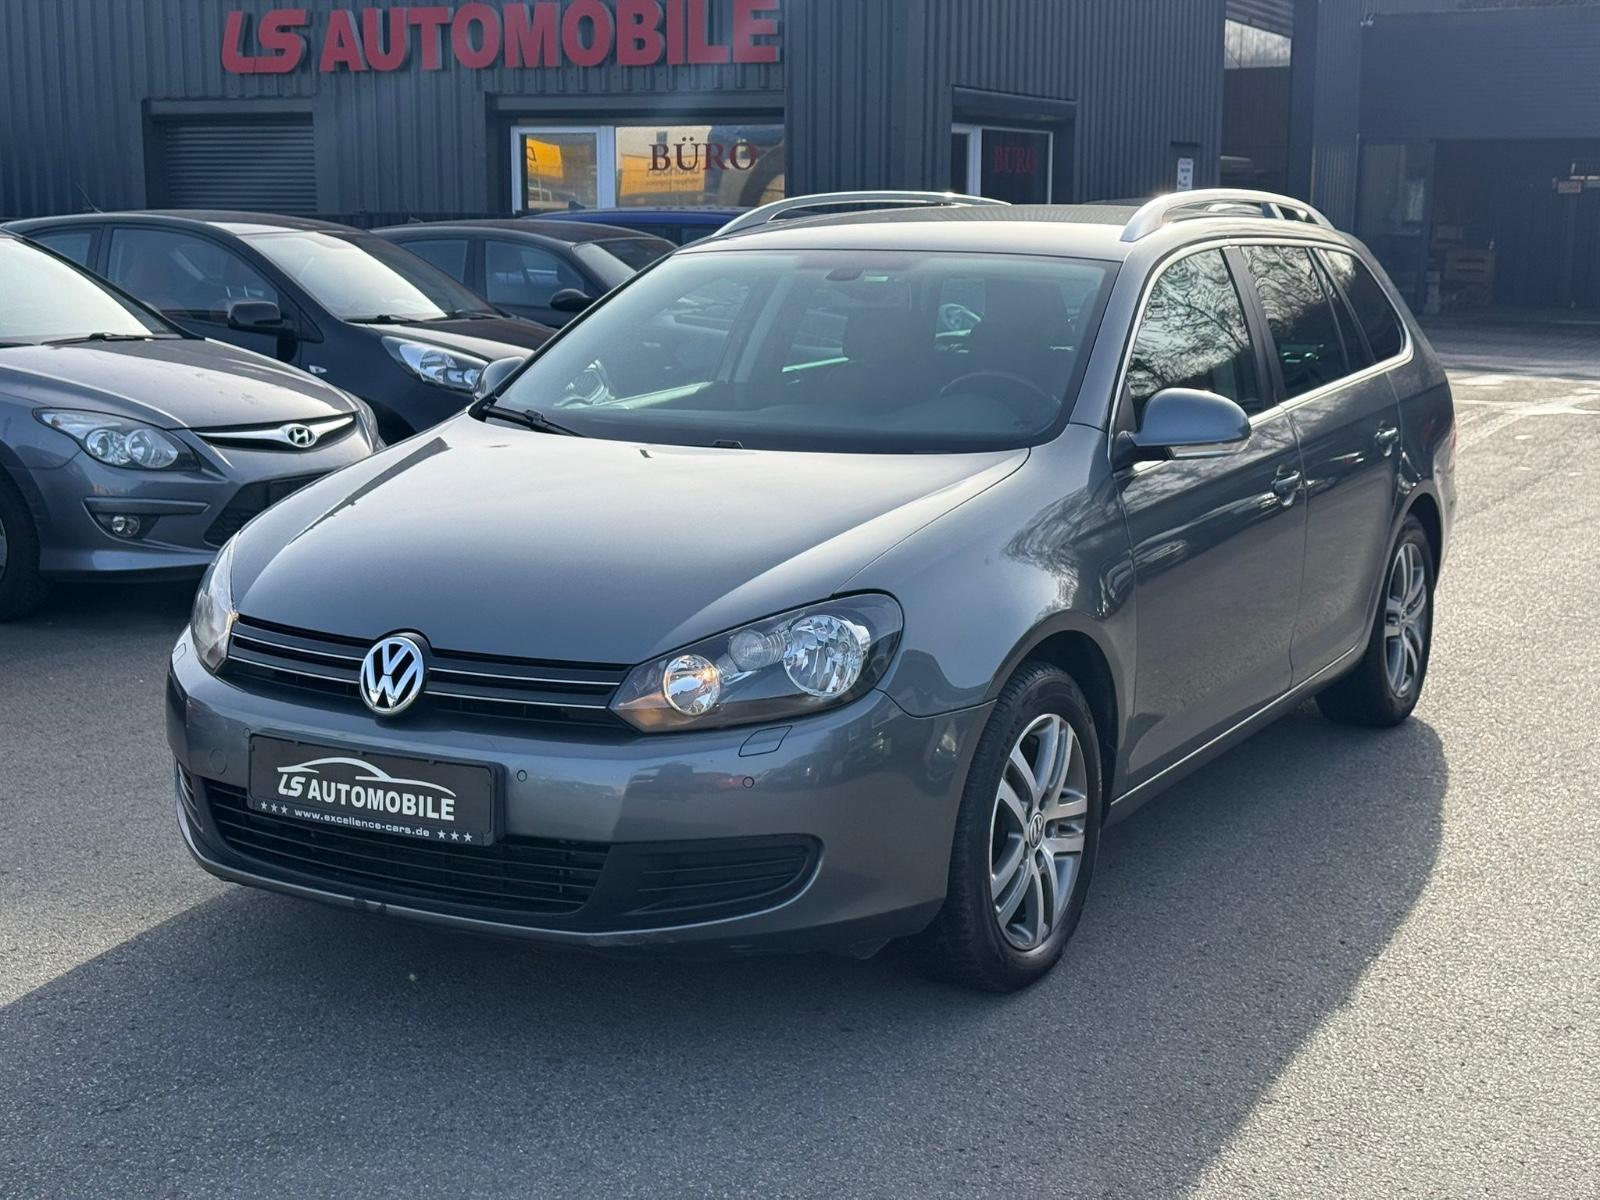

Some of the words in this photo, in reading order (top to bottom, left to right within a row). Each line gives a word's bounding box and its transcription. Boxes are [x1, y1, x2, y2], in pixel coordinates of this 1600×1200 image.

[221, 9, 308, 74] LS
[319, 0, 781, 73] AUTOMOBILE
[648, 136, 757, 171] BÜRO
[277, 774, 306, 797] LS
[307, 779, 455, 821] AUTOMOBILE
[294, 808, 430, 838] www.excellence-cars.de
